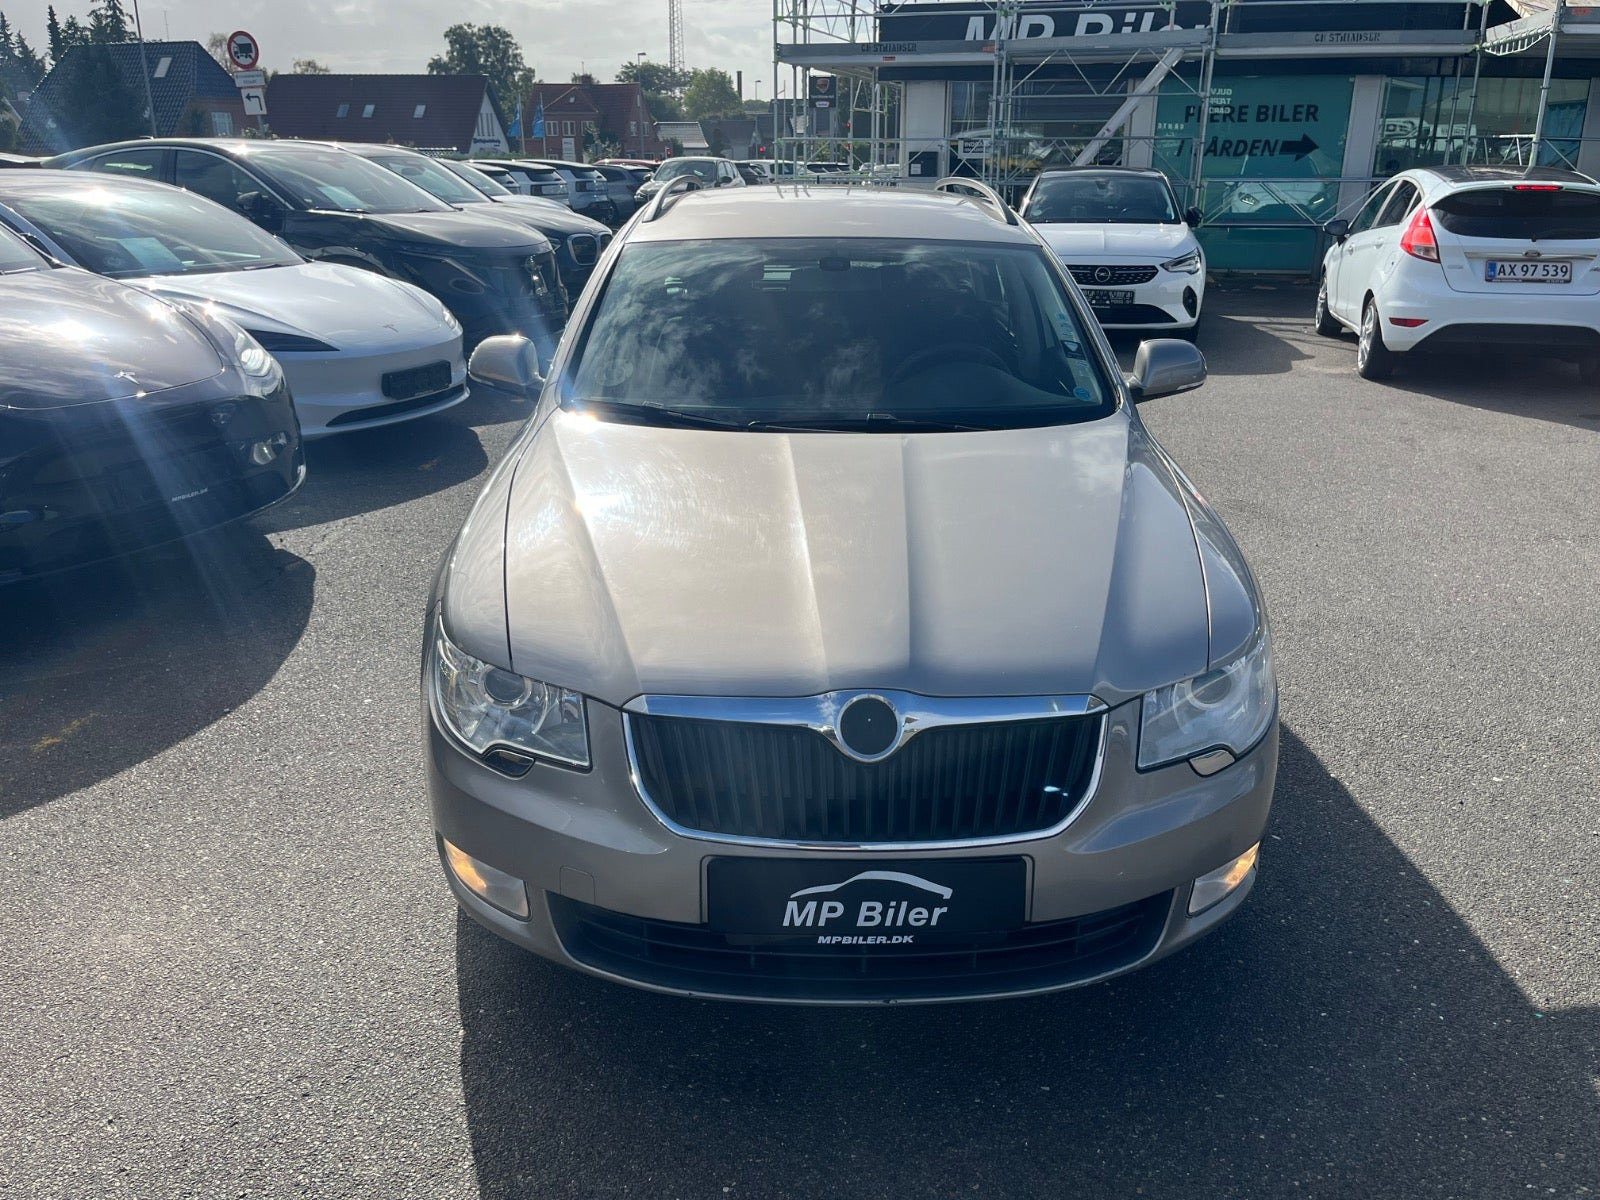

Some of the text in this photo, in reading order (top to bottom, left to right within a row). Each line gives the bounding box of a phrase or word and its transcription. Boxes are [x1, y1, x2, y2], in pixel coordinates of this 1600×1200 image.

[1255, 104, 1319, 123] BILER
[1190, 136, 1279, 158] ÅRDEN
[1497, 264, 1568, 277] AX 97 539
[782, 901, 949, 927] MP Biler
[817, 935, 915, 945] MPBILER.DK
